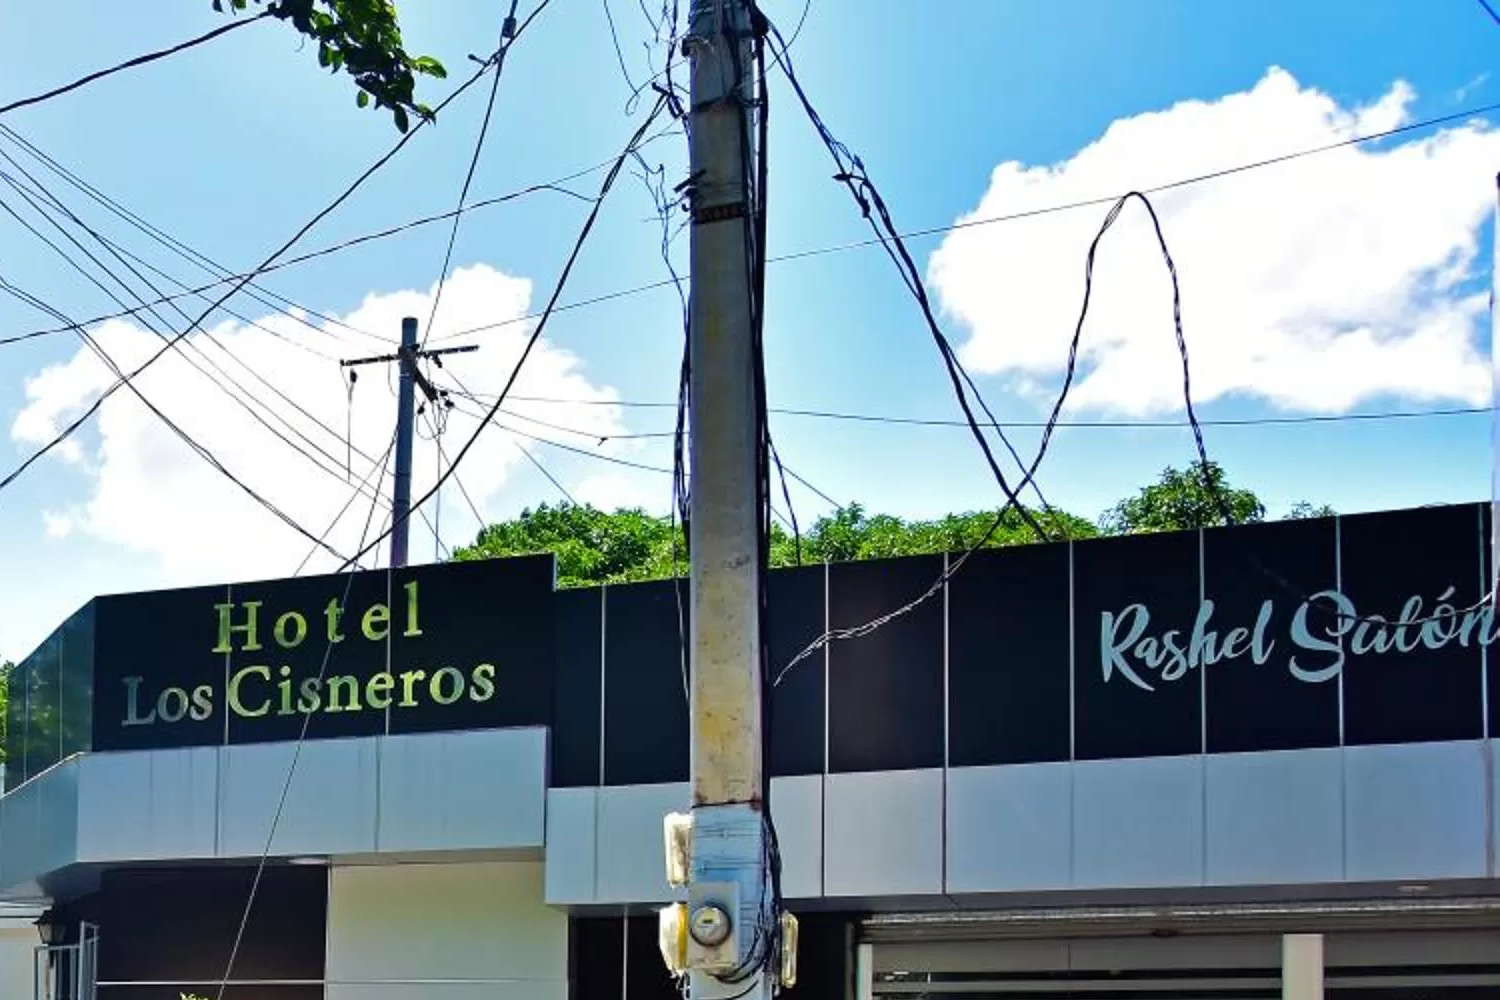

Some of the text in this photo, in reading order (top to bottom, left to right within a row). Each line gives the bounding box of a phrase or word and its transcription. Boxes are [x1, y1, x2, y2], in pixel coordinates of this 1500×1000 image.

[211, 580, 424, 653] Hotel
[1100, 586, 1500, 692] Rashel Salón
[121, 662, 496, 727] Los Cisneros
